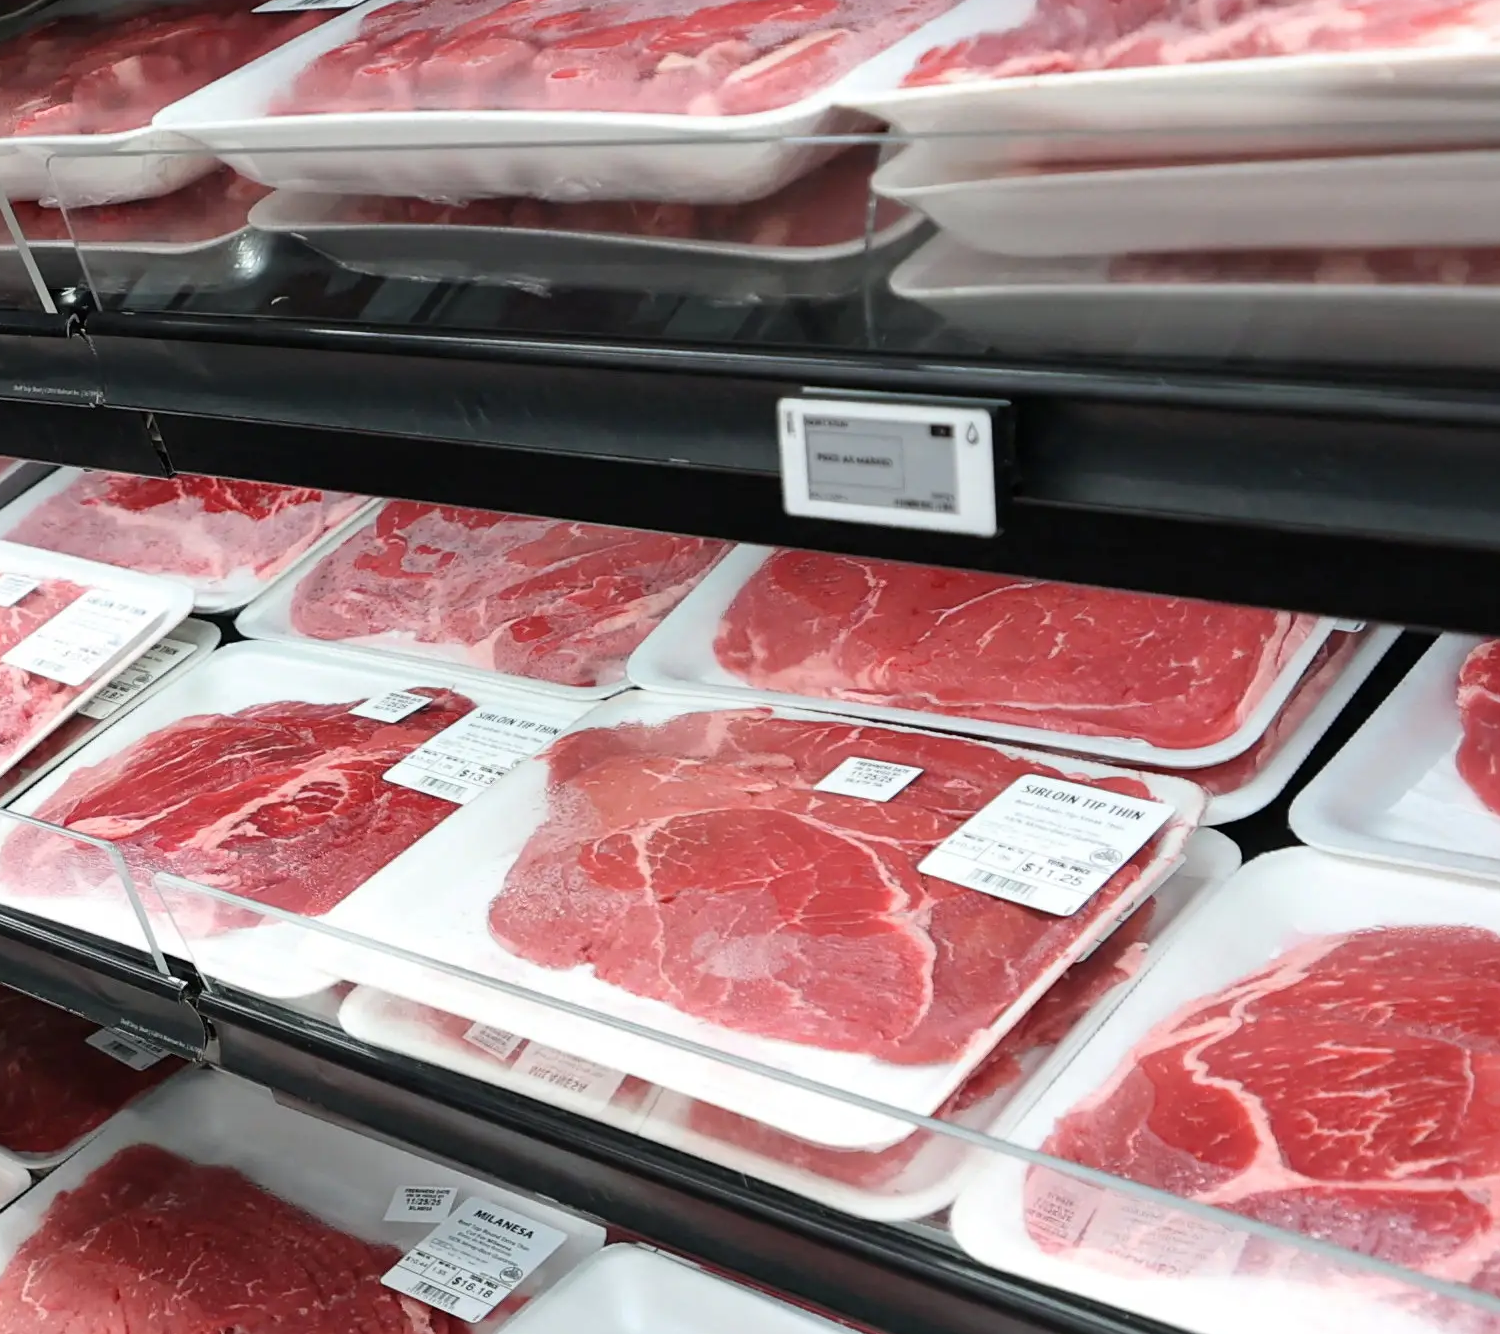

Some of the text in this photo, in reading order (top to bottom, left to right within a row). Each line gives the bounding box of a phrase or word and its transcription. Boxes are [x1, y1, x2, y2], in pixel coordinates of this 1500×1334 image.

[518, 720, 535, 730] TIP
[535, 723, 562, 736] THIN
[459, 768, 497, 786] $13.3
[1021, 784, 1146, 821] SIRLOIN TIP THIN
[1022, 862, 1082, 886] $11.25
[406, 1198, 442, 1207] 11/25/25
[473, 1209, 535, 1240] MILANESA
[451, 1276, 494, 1299] $16.18
[470, 1273, 499, 1290] TOTAL PRICE
